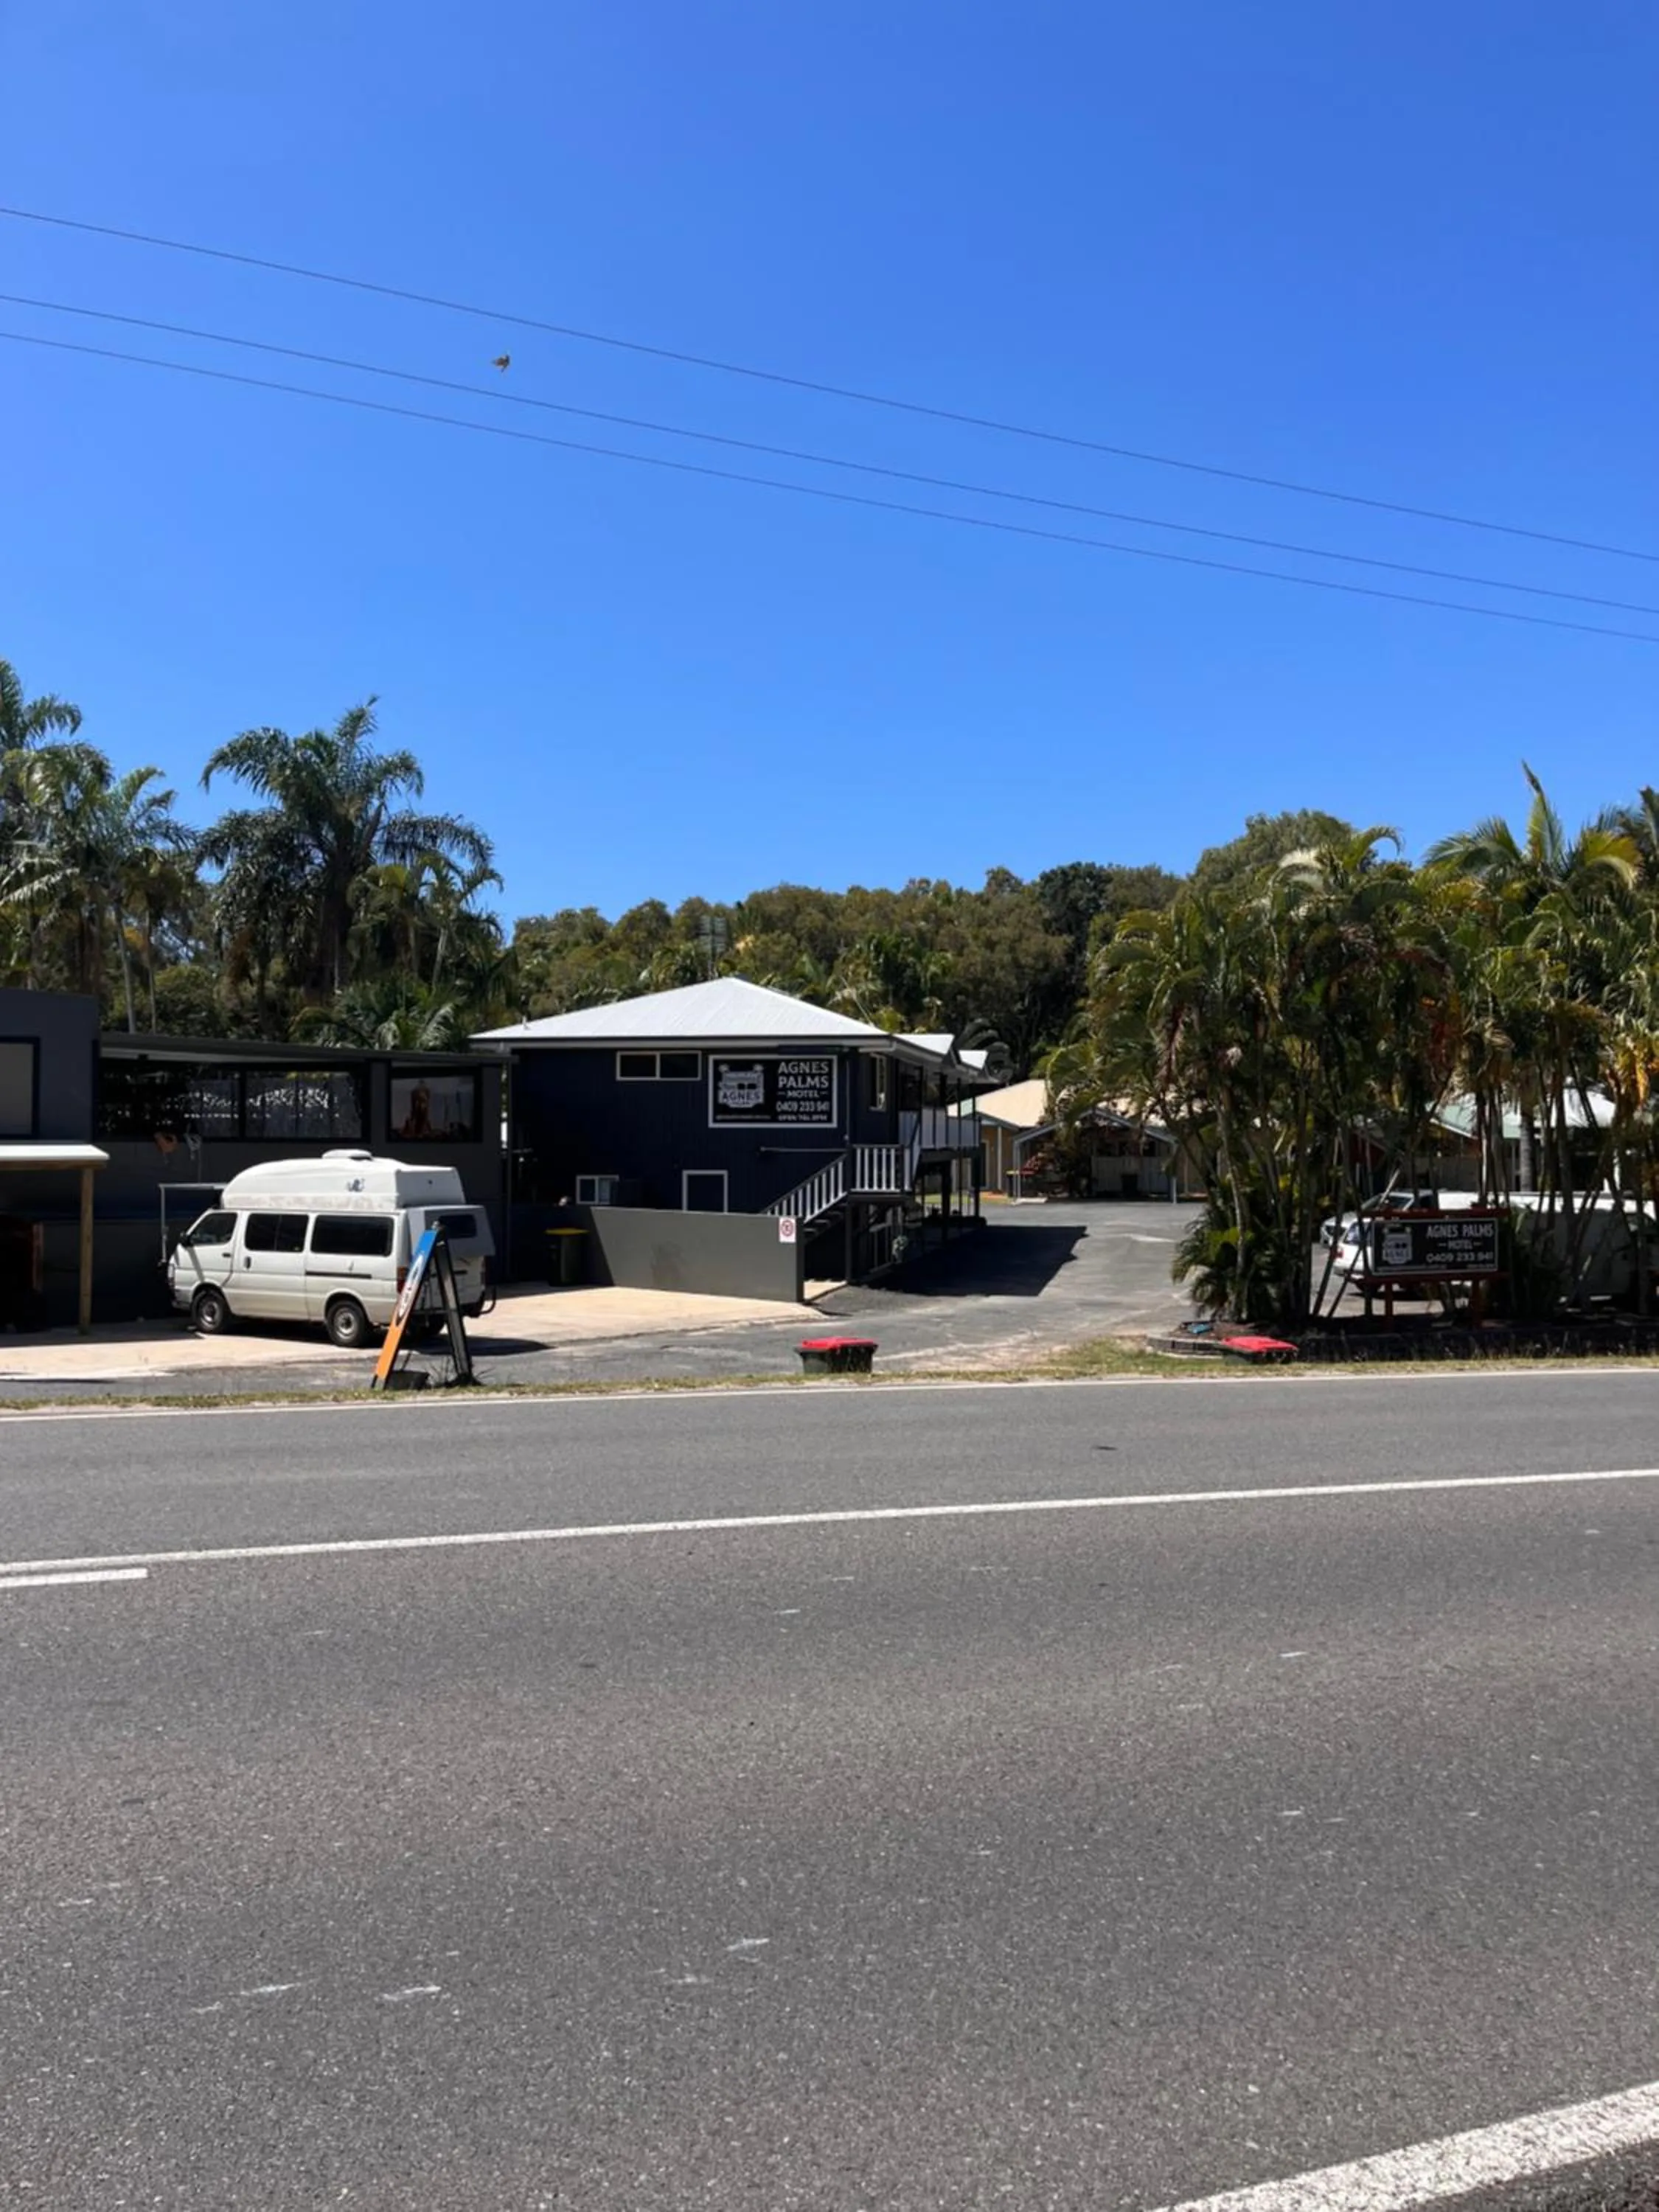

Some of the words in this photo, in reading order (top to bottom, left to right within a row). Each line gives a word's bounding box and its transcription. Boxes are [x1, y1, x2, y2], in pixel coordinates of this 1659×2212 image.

[778, 1061, 829, 1074] AGNES
[778, 1075, 829, 1088] PALMS
[723, 1091, 760, 1100] AGNES
[776, 1101, 798, 1112] 0409
[799, 1101, 815, 1112] 233
[1426, 1225, 1458, 1239] AGNES
[1462, 1223, 1493, 1238] PALMS
[1426, 1253, 1454, 1263] 0409
[1456, 1252, 1475, 1262] 233
